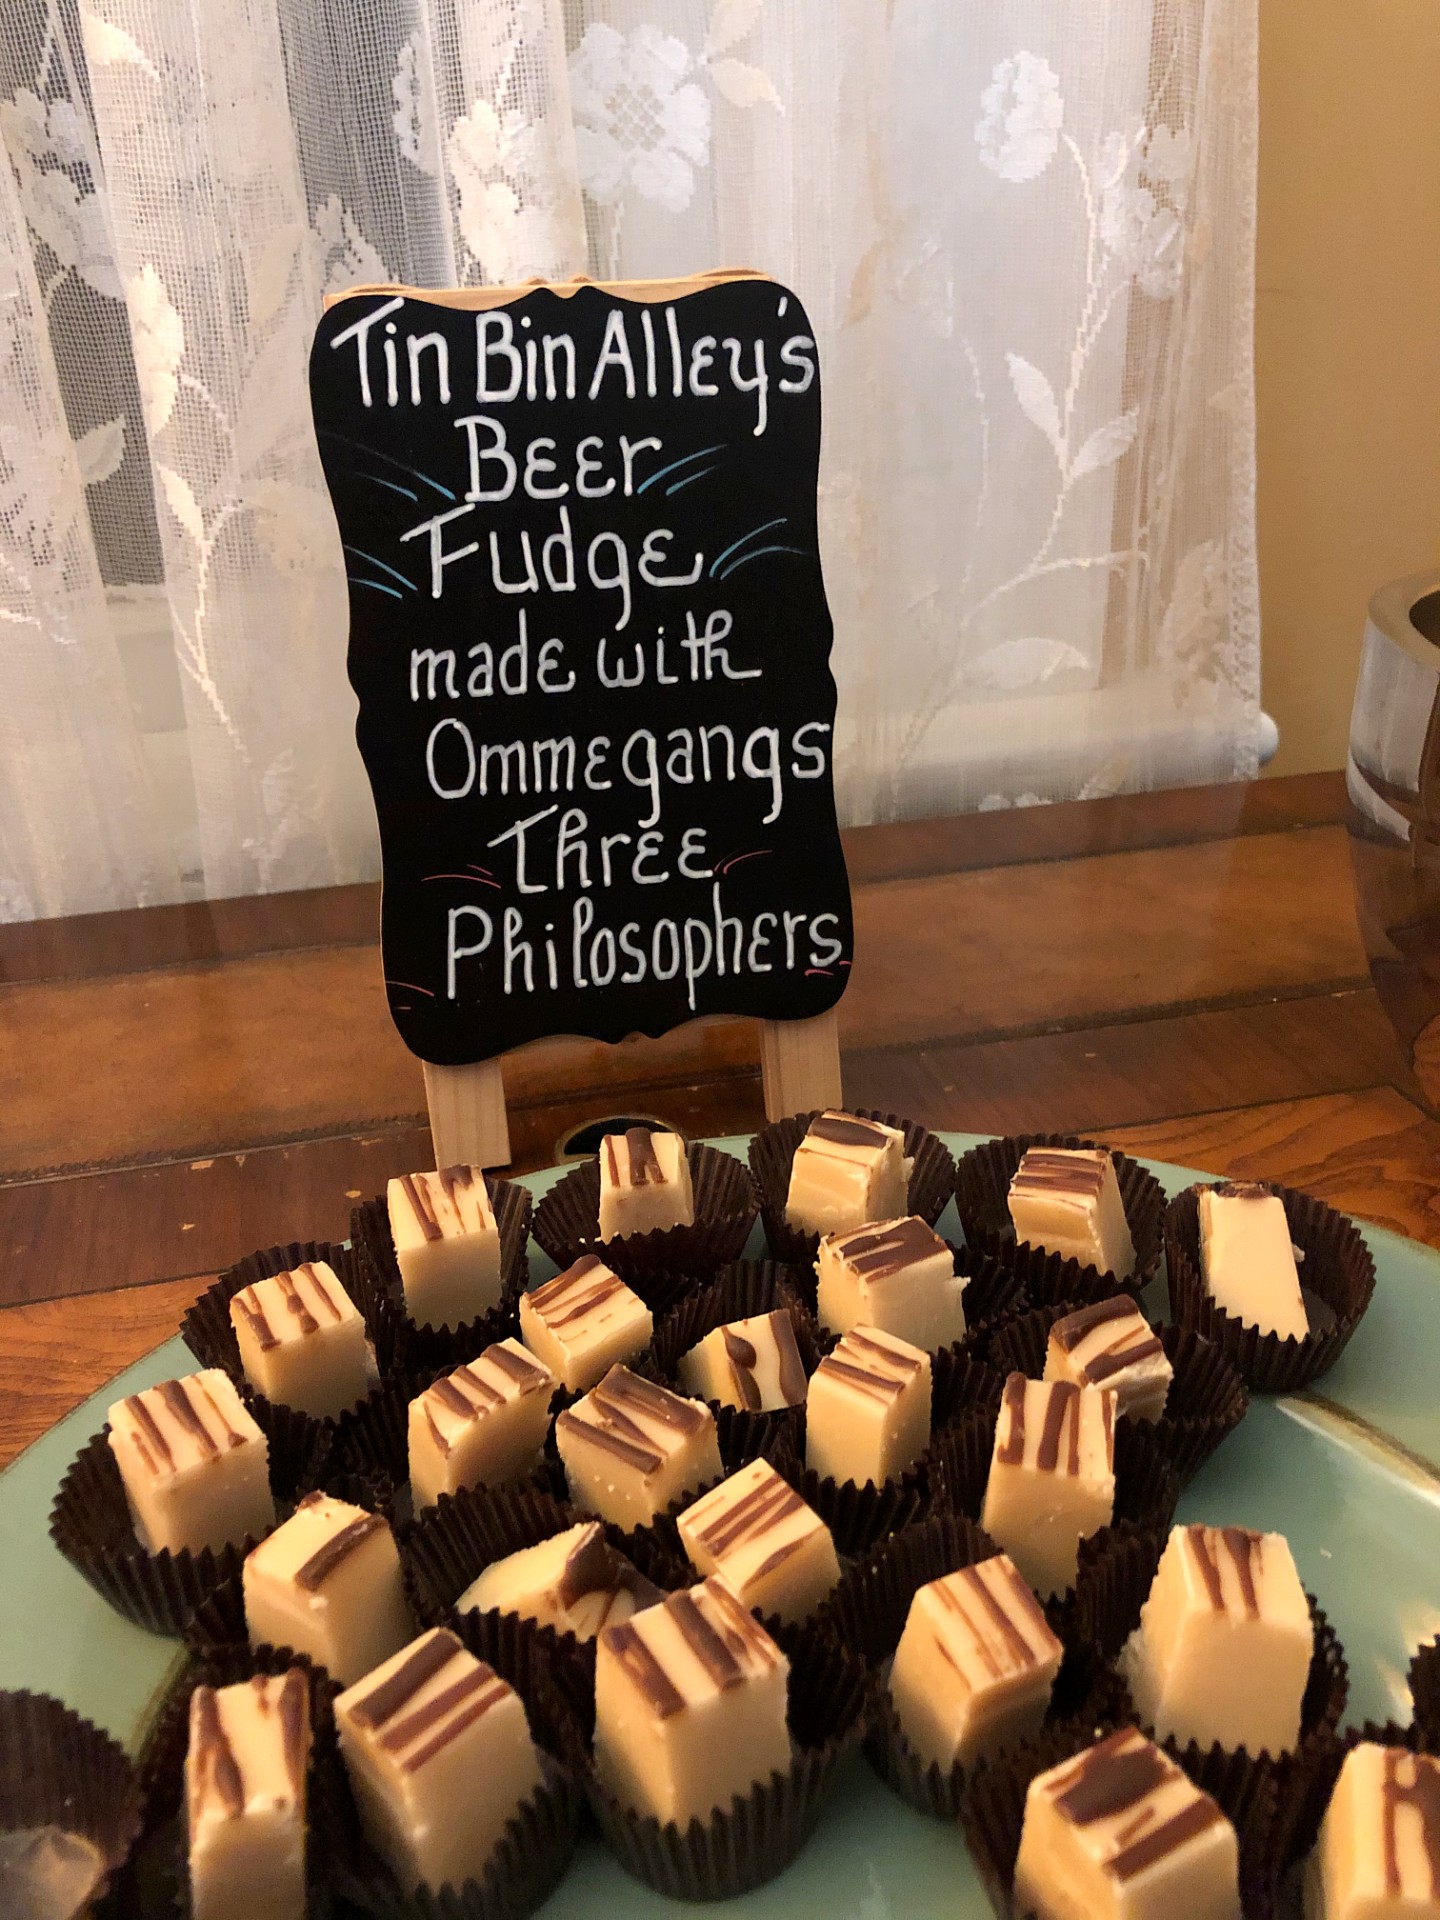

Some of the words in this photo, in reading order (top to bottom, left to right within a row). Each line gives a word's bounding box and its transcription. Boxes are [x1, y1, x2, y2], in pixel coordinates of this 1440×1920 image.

[330, 296, 451, 407] Tin
[475, 310, 577, 404] Bin
[588, 296, 815, 437] Alley's
[453, 415, 663, 503] Beer
[399, 502, 704, 631] Fudge
[410, 608, 577, 702] made
[596, 609, 763, 689] with
[425, 717, 831, 829] Ommegangs
[486, 804, 715, 894] Three
[447, 880, 843, 1011] Philosophers
